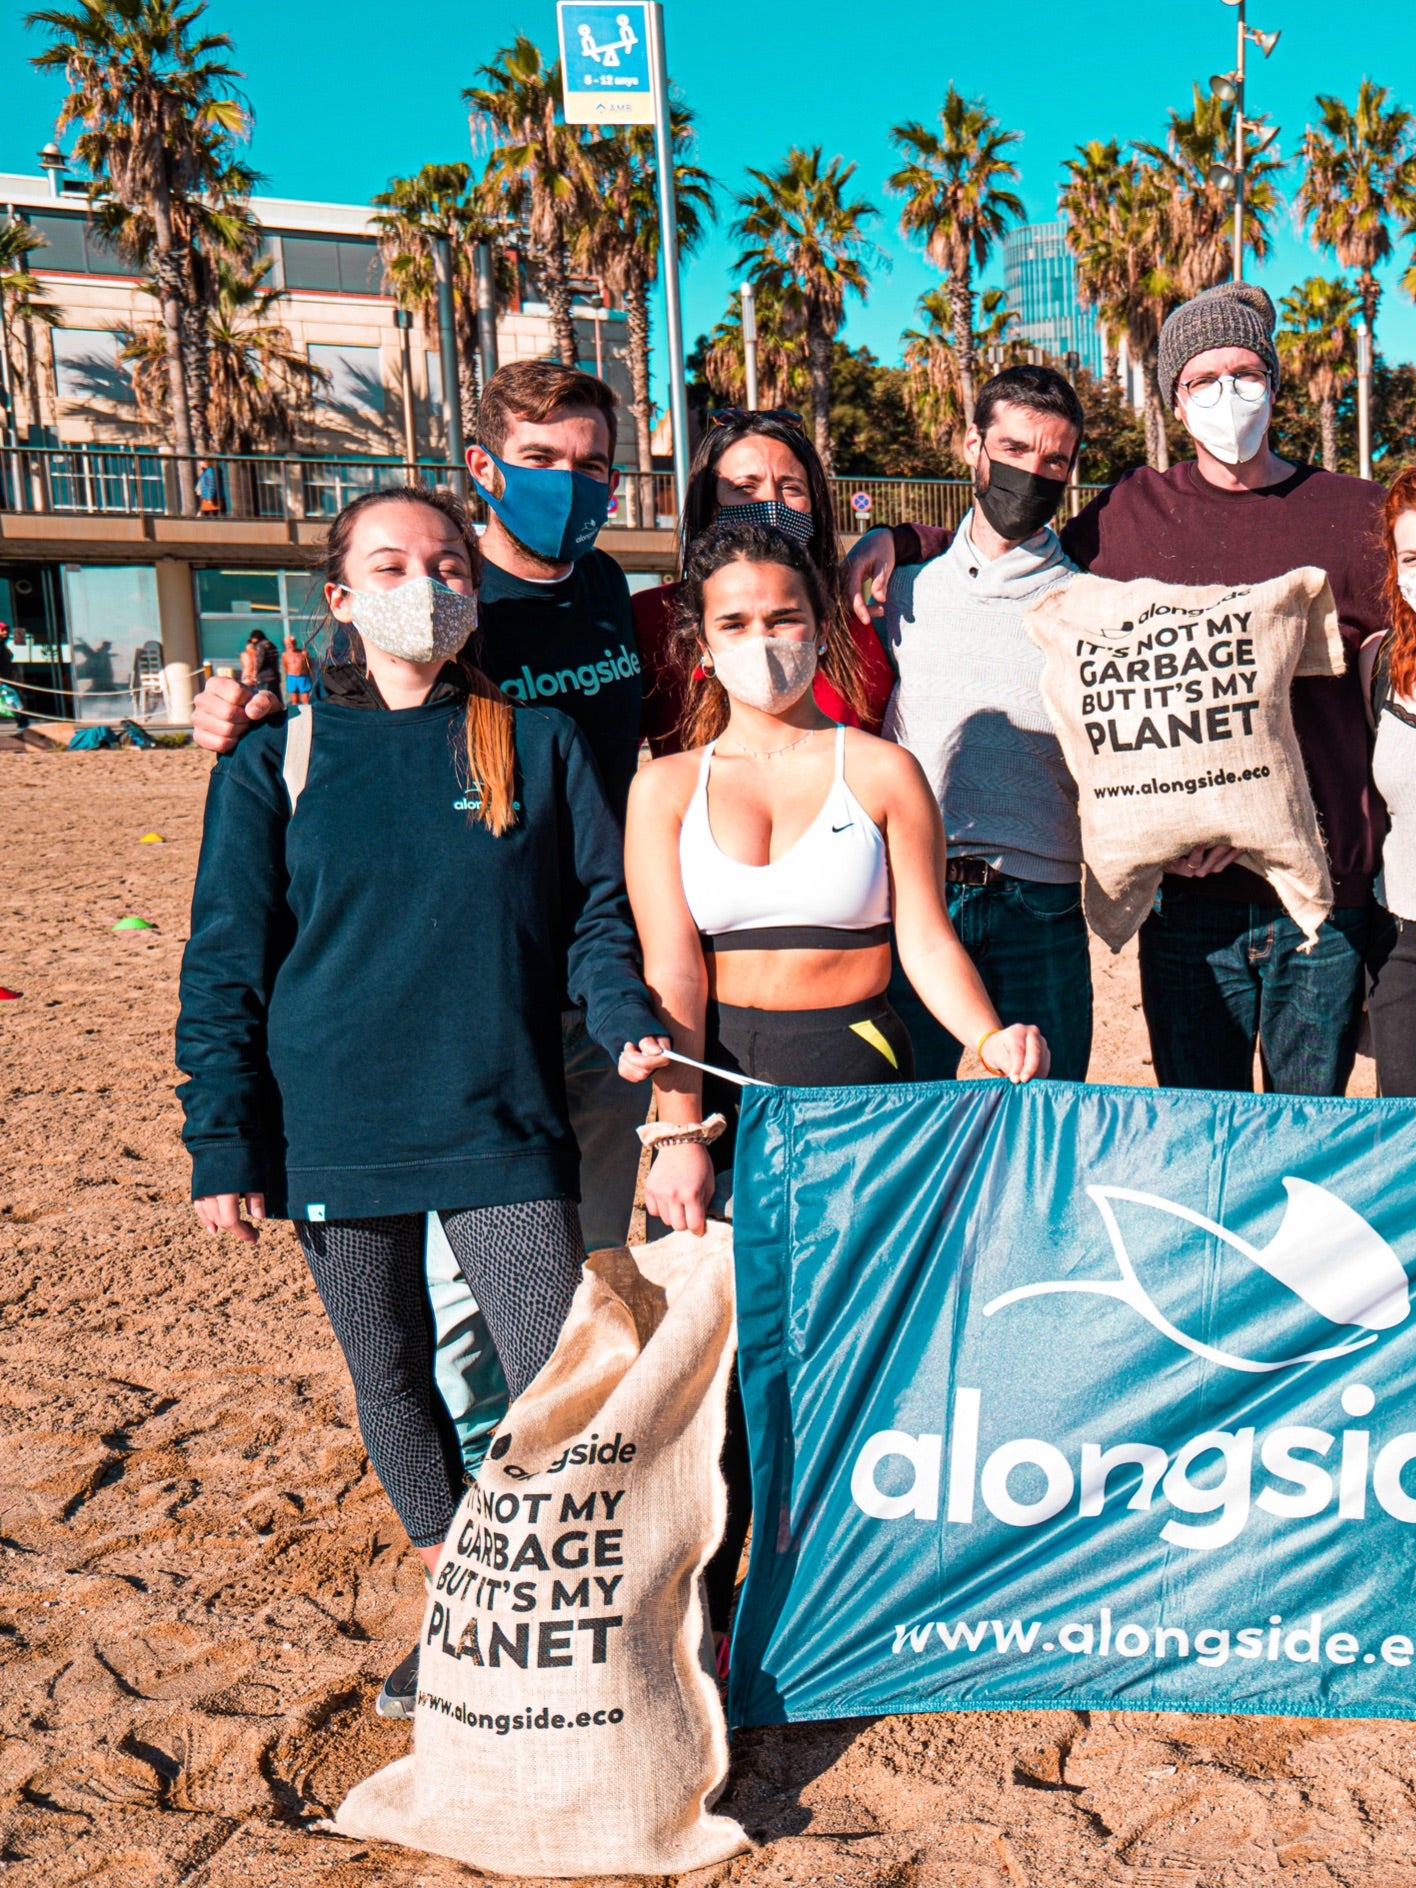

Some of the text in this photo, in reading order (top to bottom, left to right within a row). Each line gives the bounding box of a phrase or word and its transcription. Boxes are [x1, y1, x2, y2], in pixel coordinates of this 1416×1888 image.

[1076, 611, 1253, 659] IT'S NOT MY
[500, 644, 641, 701] alongside
[1079, 639, 1256, 687] GARBAGE
[1082, 671, 1258, 715] BUT IT'S MY
[1084, 700, 1260, 755] PLANET
[1093, 765, 1271, 800] www.alongside.eco
[483, 1490, 552, 1524] NOT
[559, 1490, 626, 1523] MY
[457, 1518, 624, 1573] GARBAGE
[436, 1563, 624, 1613] BUT IT'S MY
[427, 1600, 624, 1670] PLANET
[417, 1690, 624, 1736] www.alongside.eco
